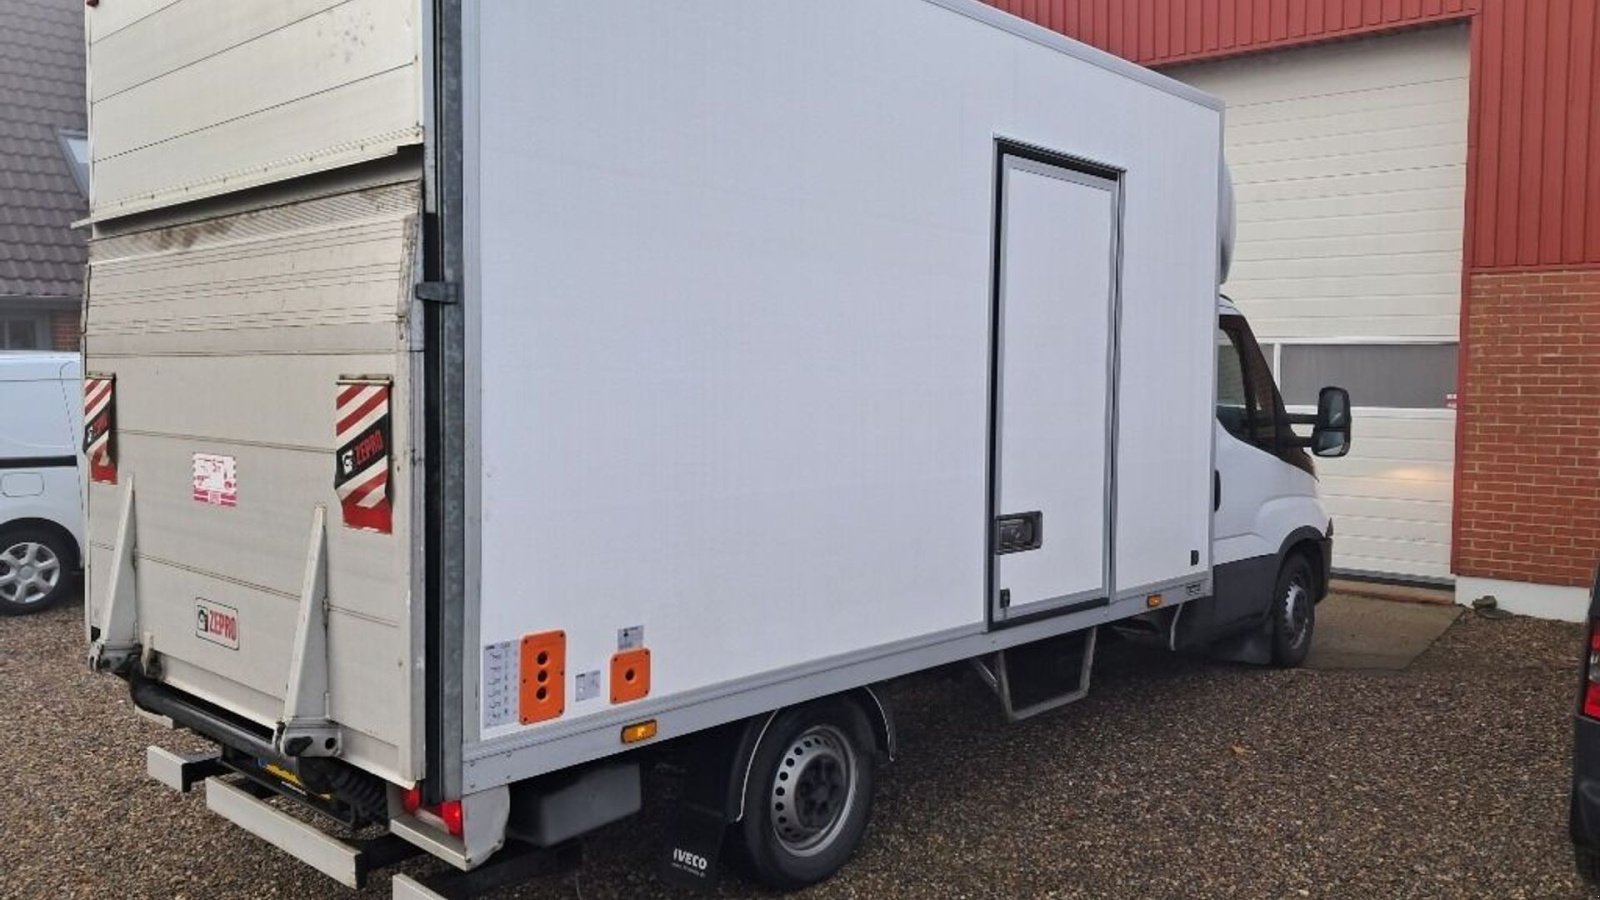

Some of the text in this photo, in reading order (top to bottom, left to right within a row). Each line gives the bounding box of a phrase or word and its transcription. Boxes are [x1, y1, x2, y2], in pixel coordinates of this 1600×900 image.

[355, 430, 383, 466] ZEPRO
[209, 609, 237, 642] ZEPRO
[673, 848, 708, 870] IVECO
